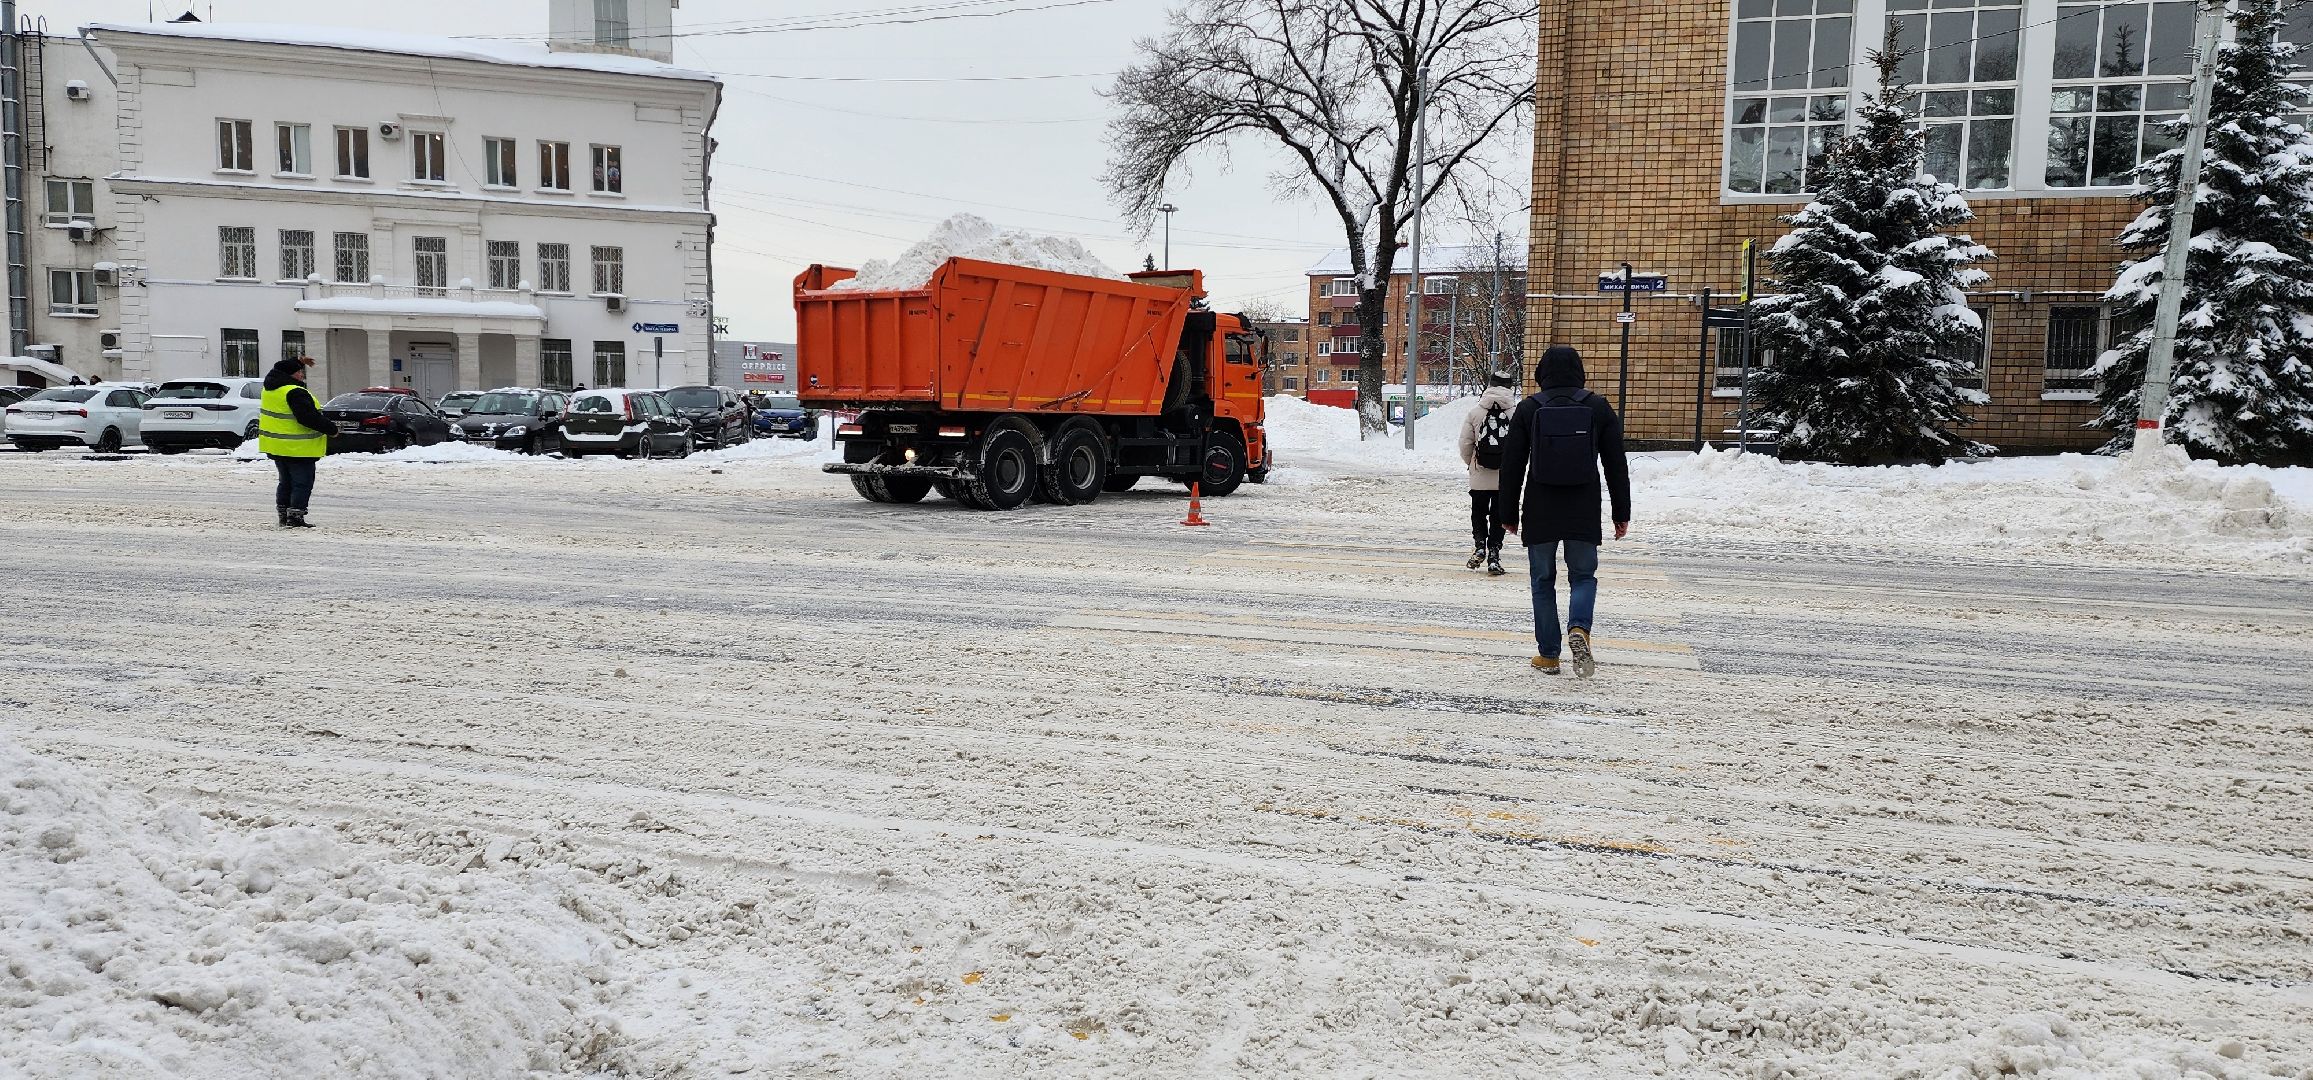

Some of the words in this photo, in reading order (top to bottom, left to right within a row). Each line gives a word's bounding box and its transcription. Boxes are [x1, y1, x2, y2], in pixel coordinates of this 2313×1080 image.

[1656, 280, 1664, 289] 2
[760, 351, 783, 361] KFC
[741, 362, 787, 372] OFFPRICE
[744, 372, 767, 381] DNS
